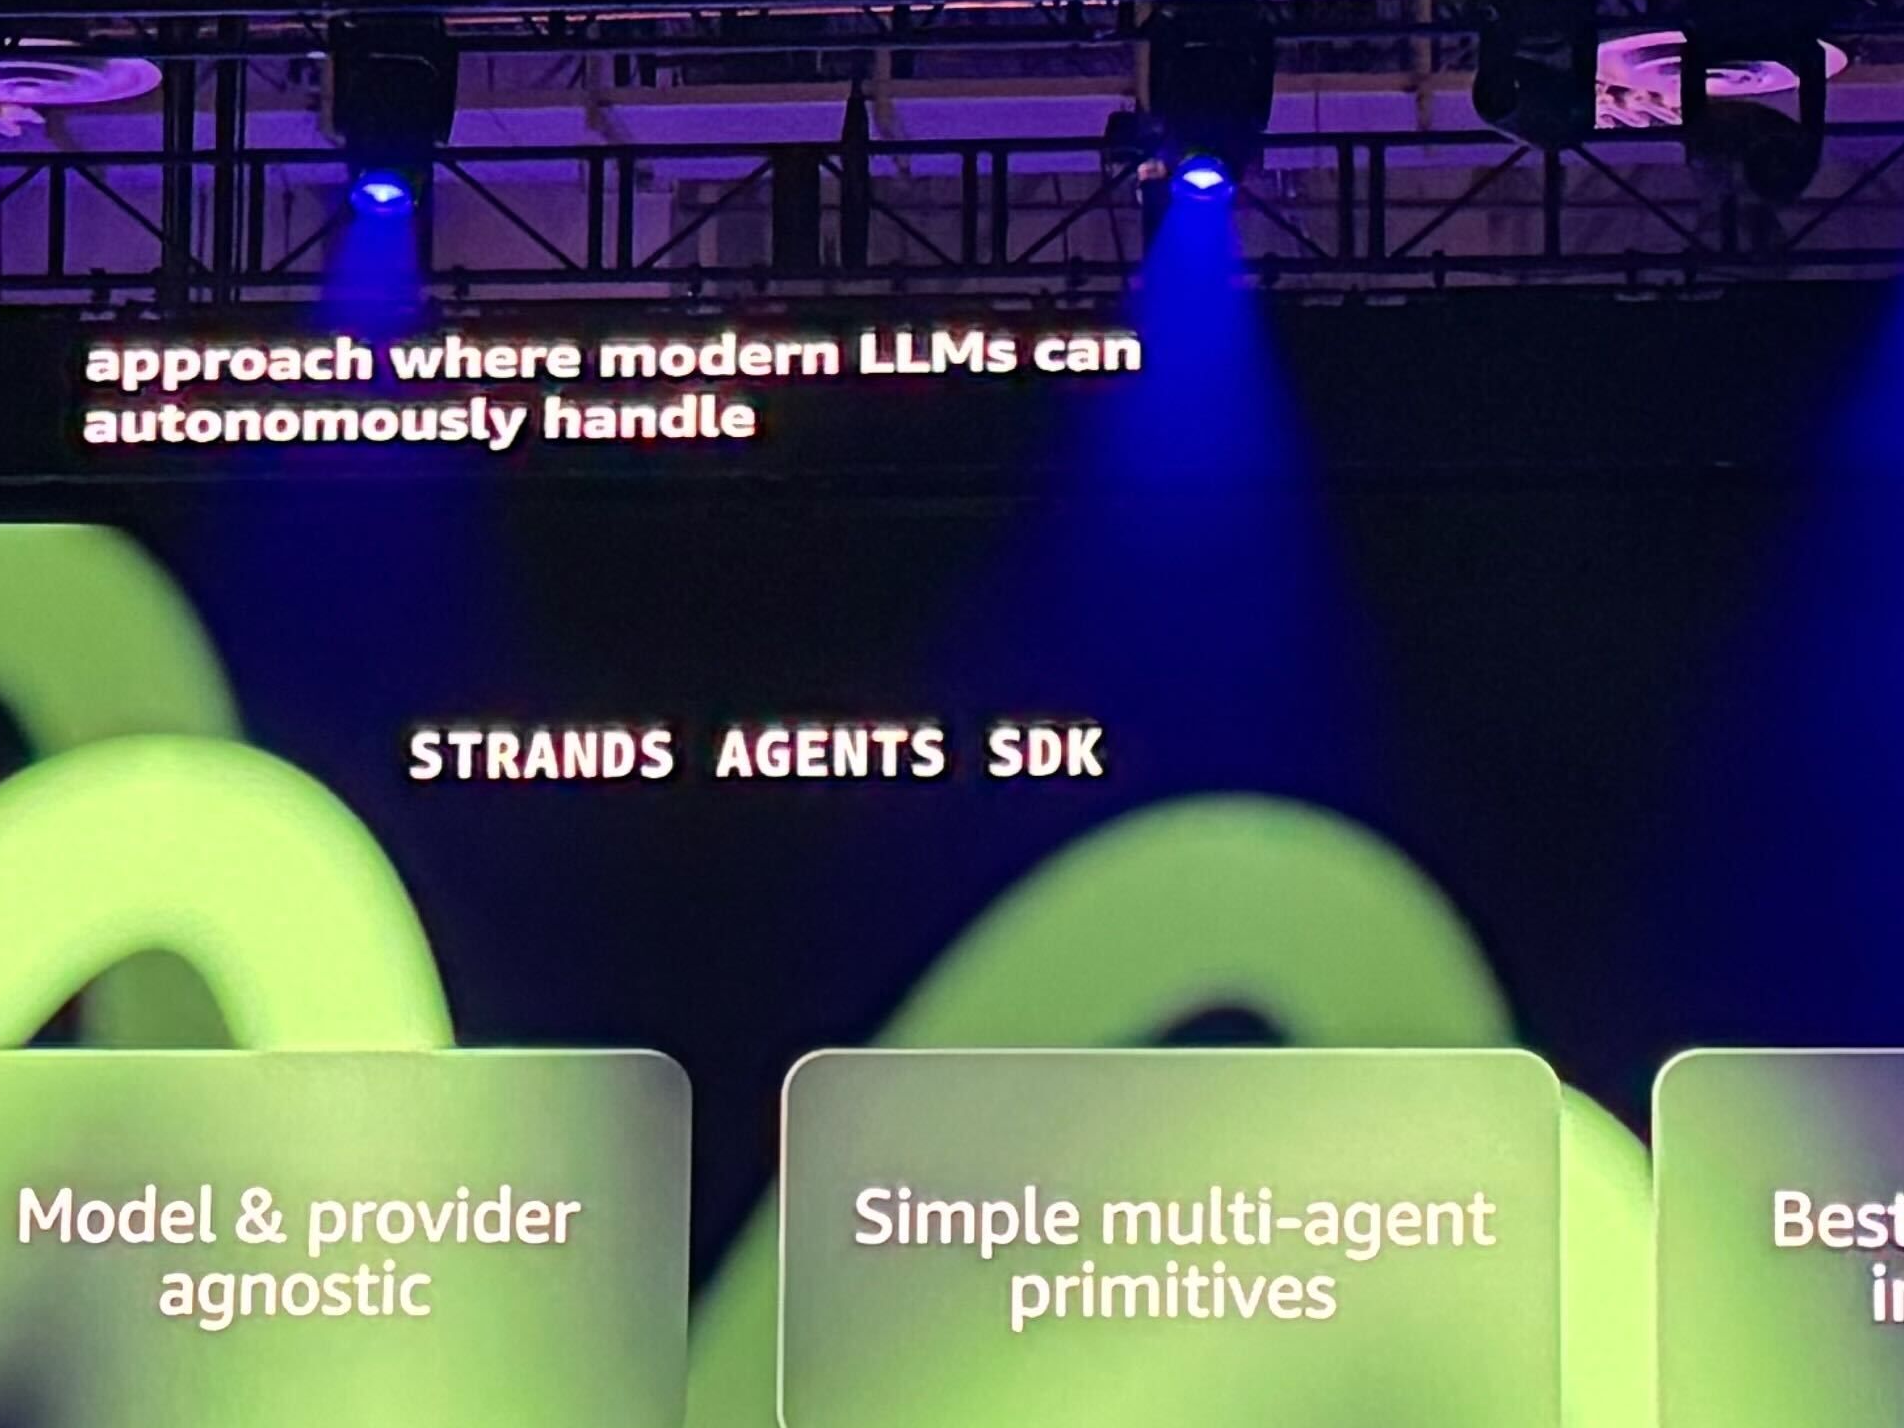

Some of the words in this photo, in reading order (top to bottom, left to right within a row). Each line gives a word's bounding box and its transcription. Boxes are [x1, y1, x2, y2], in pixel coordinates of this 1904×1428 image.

[86, 336, 372, 392] approach
[390, 335, 581, 380] where
[599, 330, 839, 378] modern
[859, 329, 1017, 375] LLMs
[1033, 336, 1141, 373] can
[83, 396, 527, 451] autonomously
[543, 392, 756, 439] handle
[409, 728, 674, 780] STRANDS
[715, 725, 945, 778] AGENTS
[988, 726, 1104, 777] SDK
[19, 1183, 217, 1244] Model
[234, 1186, 288, 1244] &
[308, 1185, 582, 1258] provider
[855, 1186, 1080, 1260] Simple
[1102, 1185, 1497, 1264] multi-agent
[158, 1260, 432, 1332] agnostic
[1008, 1260, 1338, 1333] primitives
